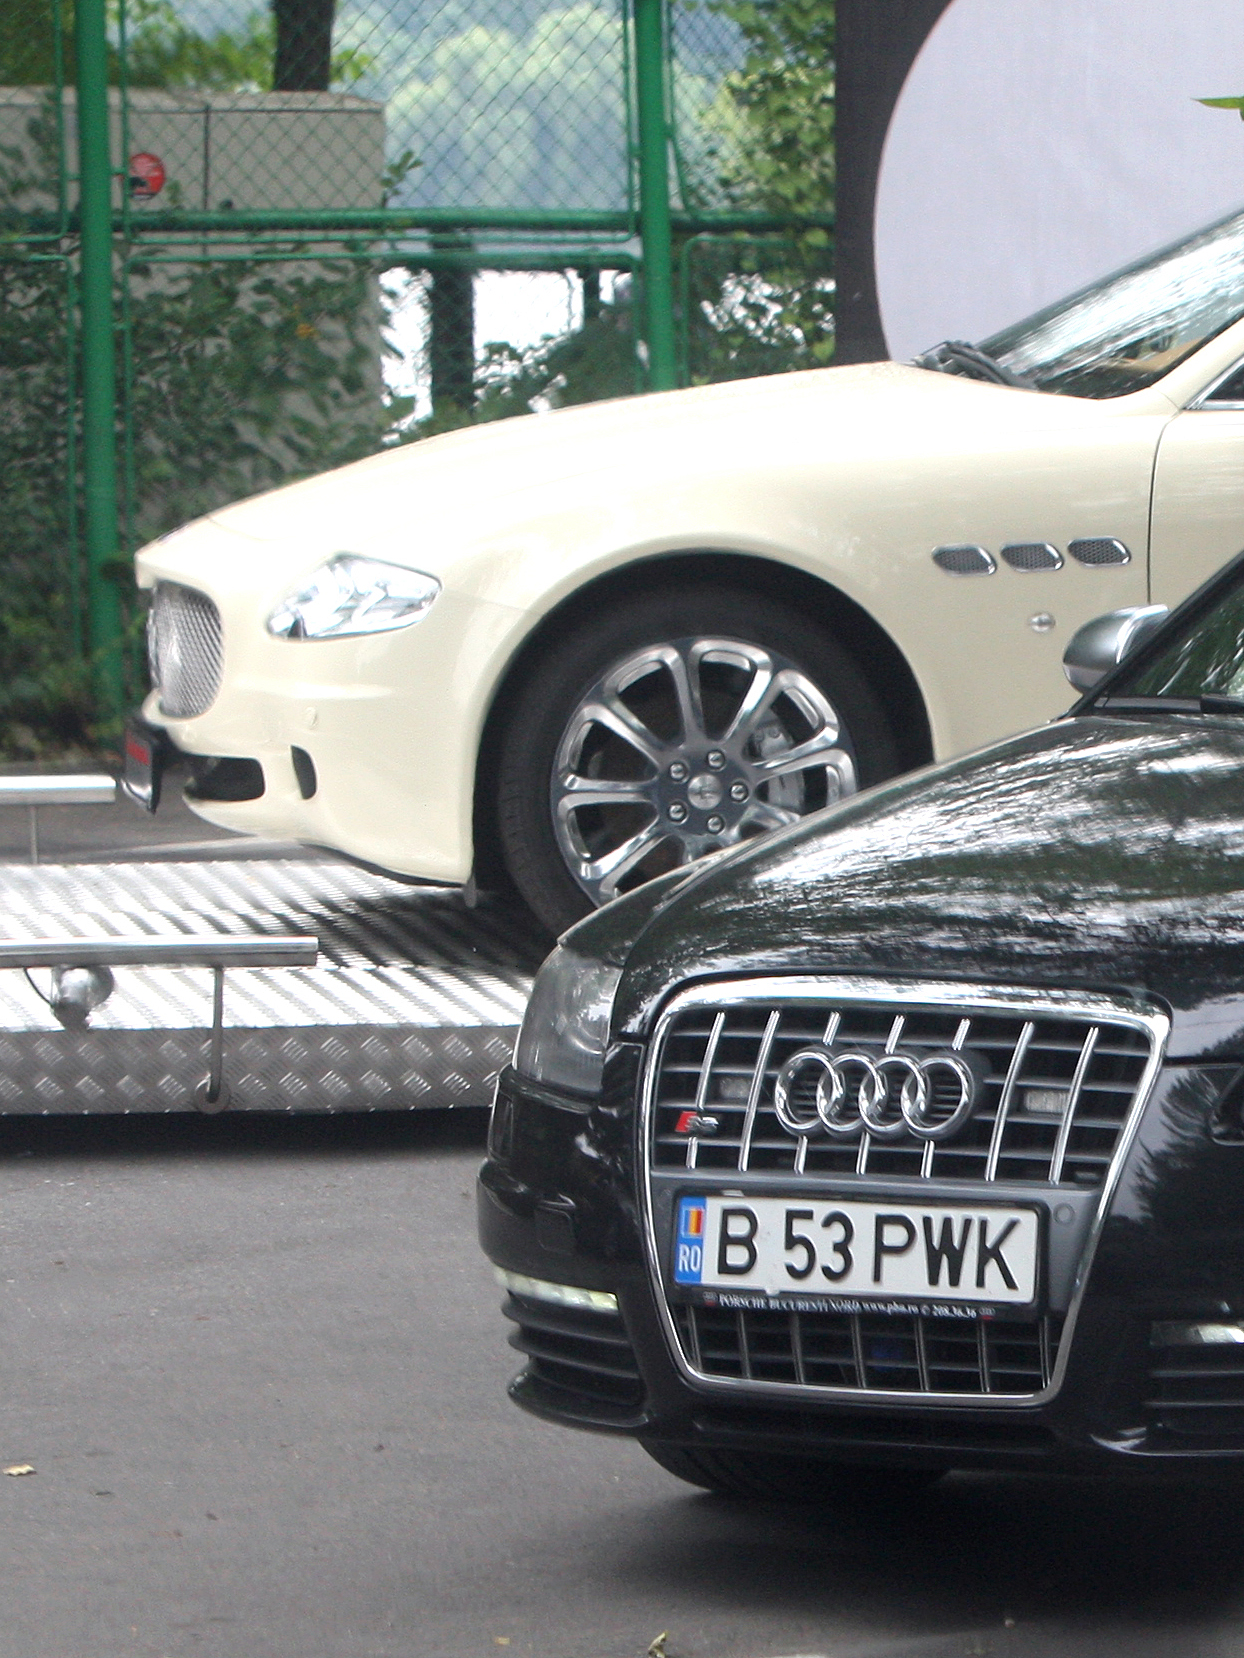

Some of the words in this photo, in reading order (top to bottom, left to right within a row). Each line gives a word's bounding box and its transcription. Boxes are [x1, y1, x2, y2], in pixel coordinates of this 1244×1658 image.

[678, 1243, 701, 1272] RO
[717, 1205, 760, 1275] B
[784, 1208, 856, 1281] 53
[872, 1213, 1021, 1291] PWK
